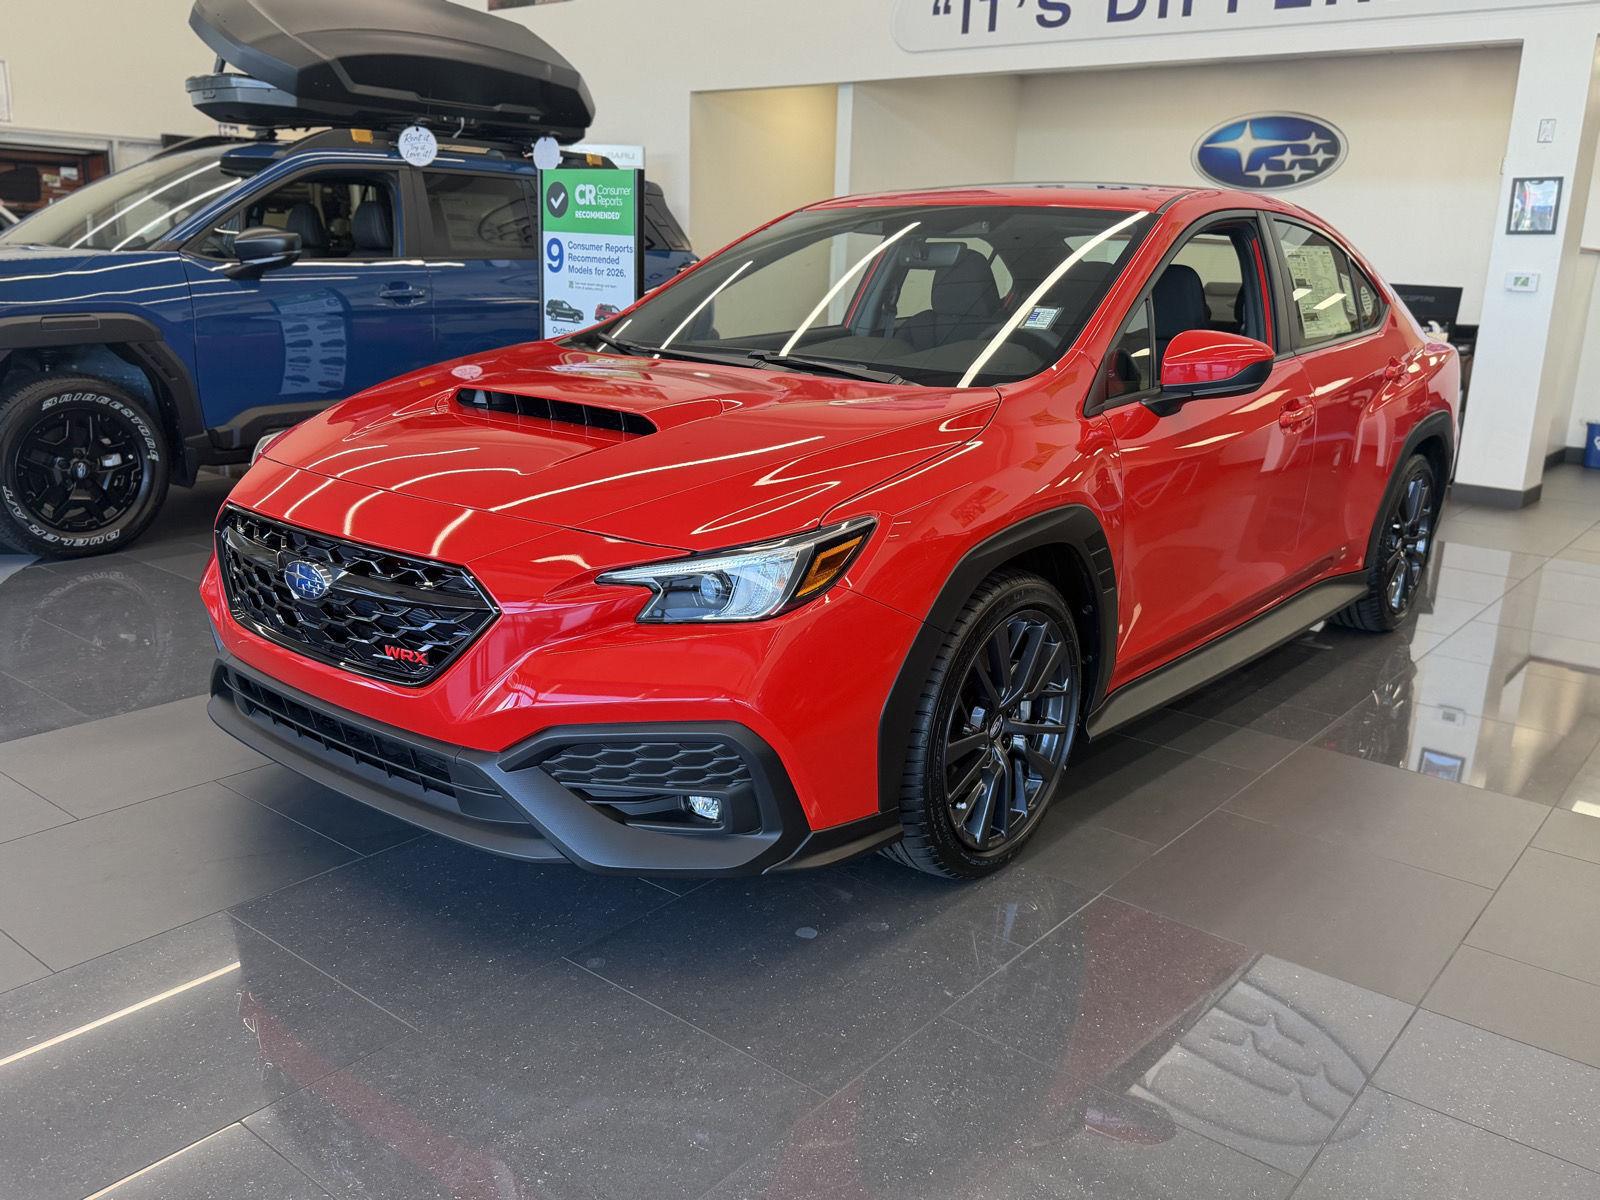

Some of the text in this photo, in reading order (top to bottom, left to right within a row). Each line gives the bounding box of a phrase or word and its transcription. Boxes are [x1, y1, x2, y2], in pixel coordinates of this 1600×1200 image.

[575, 184, 596, 205] CR
[597, 185, 631, 196] Consumer
[597, 195, 623, 207] Reports
[575, 210, 620, 220] RECOMMENDED
[567, 241, 633, 254] Consumer Reports
[546, 237, 565, 273] 9
[568, 253, 620, 265] Recommended
[568, 265, 627, 278] Models for 2026.
[42, 393, 160, 462] BRIDGESTONE
[384, 644, 429, 665] WRX
